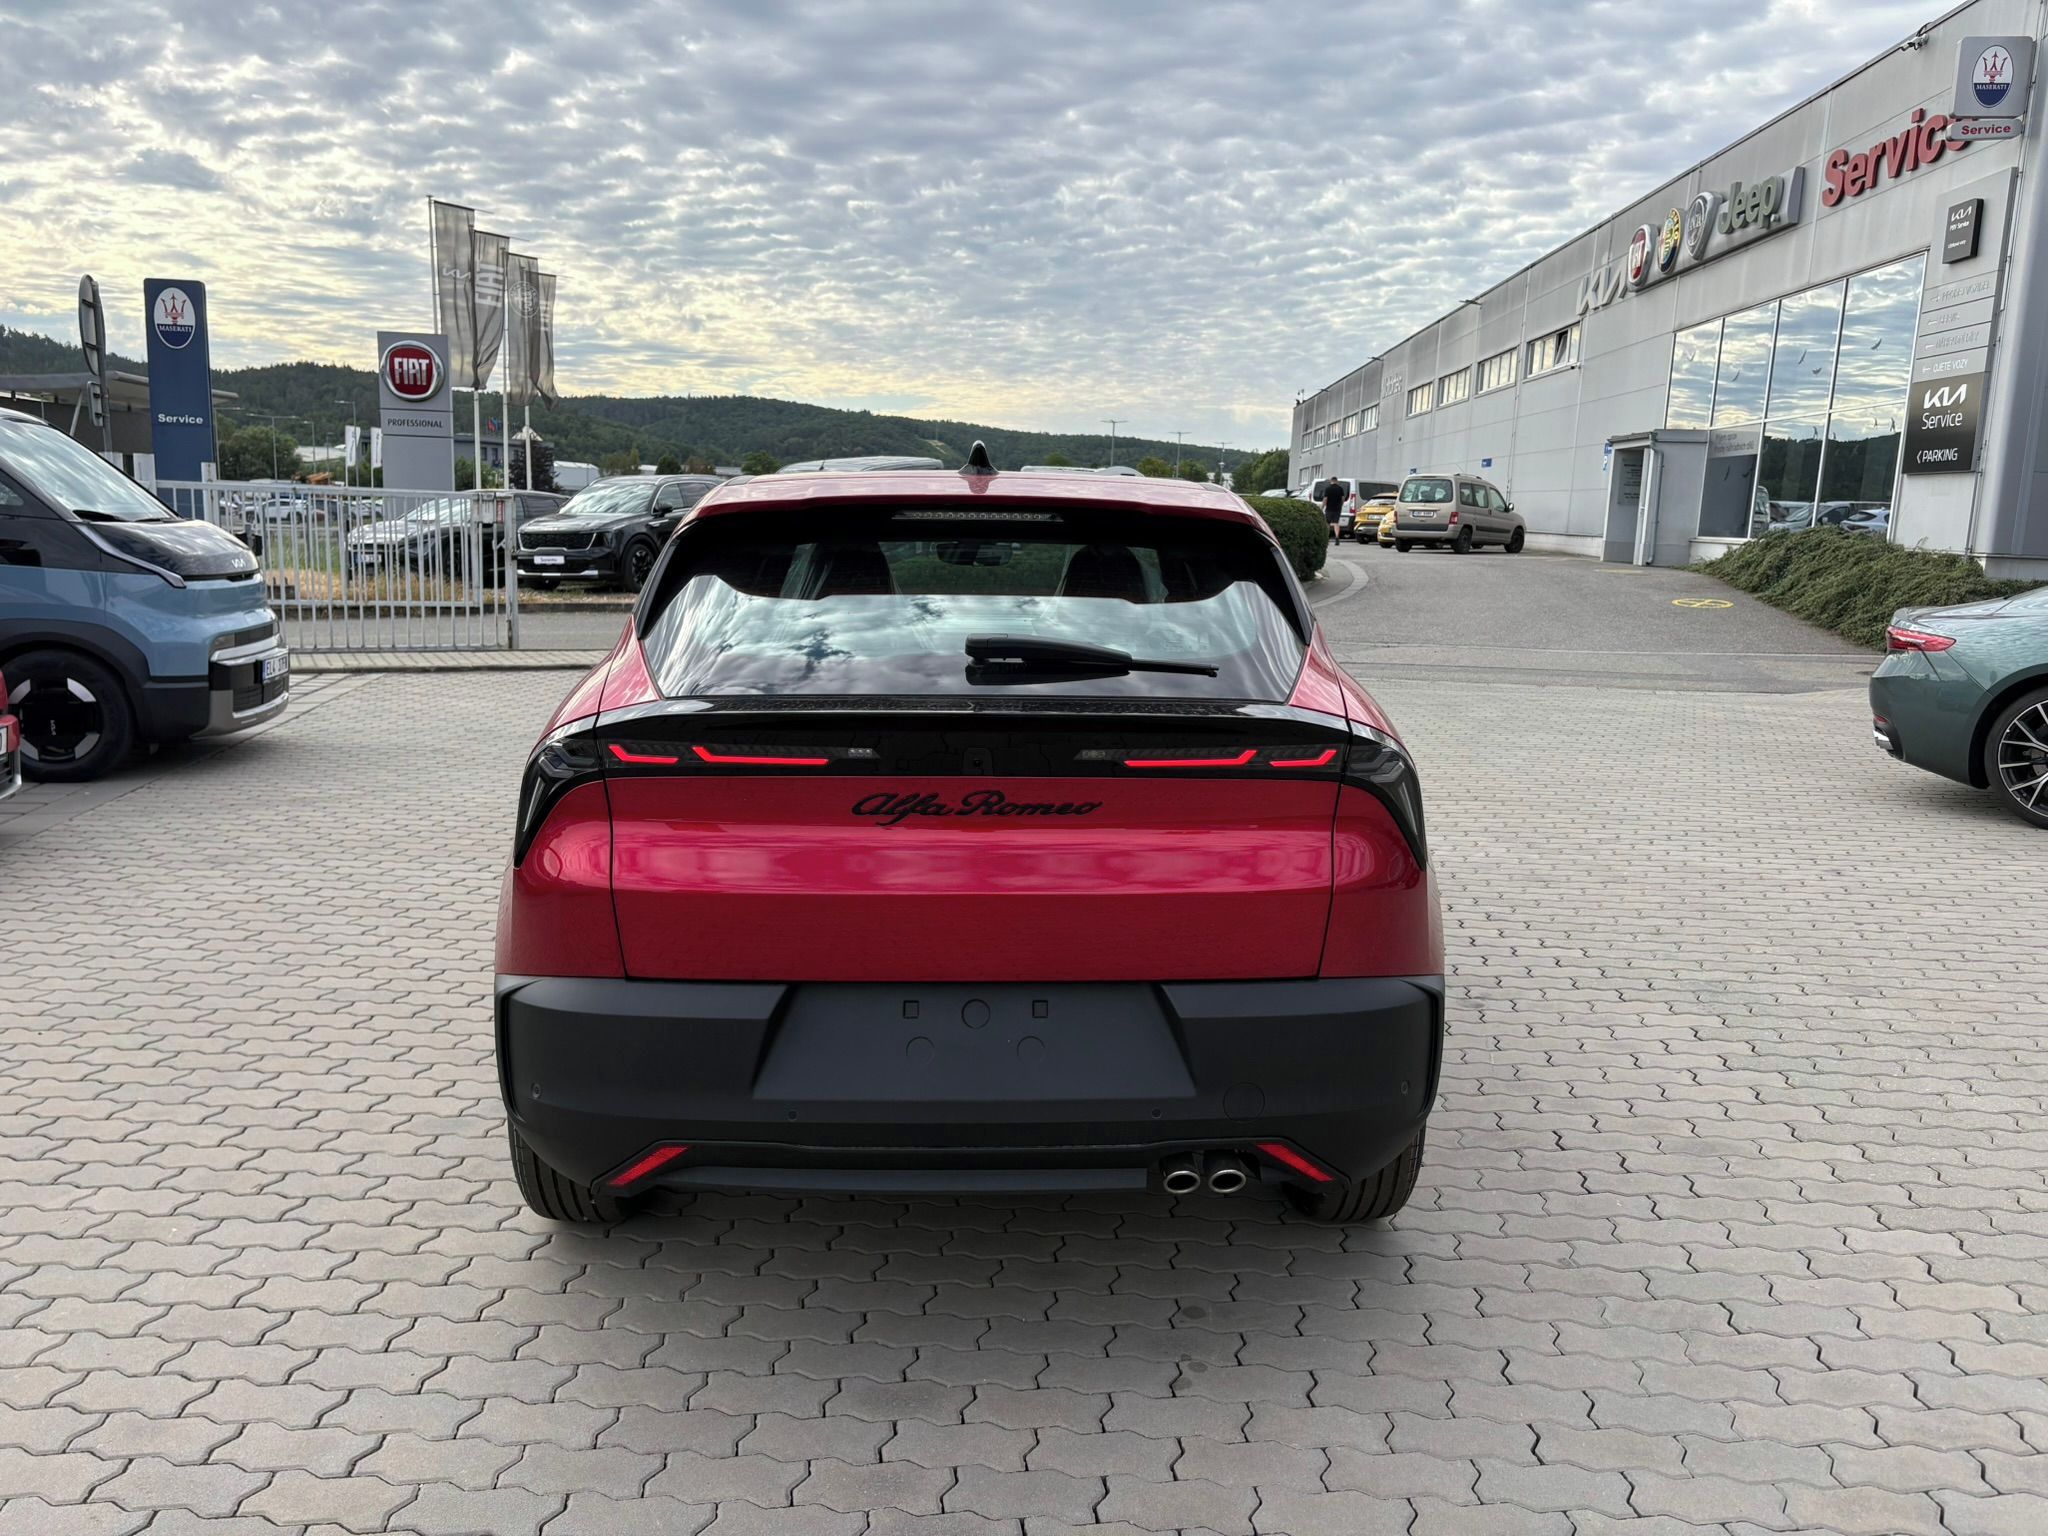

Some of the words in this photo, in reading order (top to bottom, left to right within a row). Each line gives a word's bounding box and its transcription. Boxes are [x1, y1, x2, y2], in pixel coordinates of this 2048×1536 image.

[1961, 124, 2011, 135] Service
[1717, 175, 1784, 234] Jeep
[158, 324, 193, 332] MASERATI
[393, 357, 430, 386] FIAT
[157, 413, 204, 425] Service
[387, 418, 443, 429] PROFESSIONAL
[1921, 410, 1963, 430] Service
[1922, 447, 1958, 463] PARKING
[851, 792, 953, 826] Alfa
[954, 790, 1104, 816] Romeo
